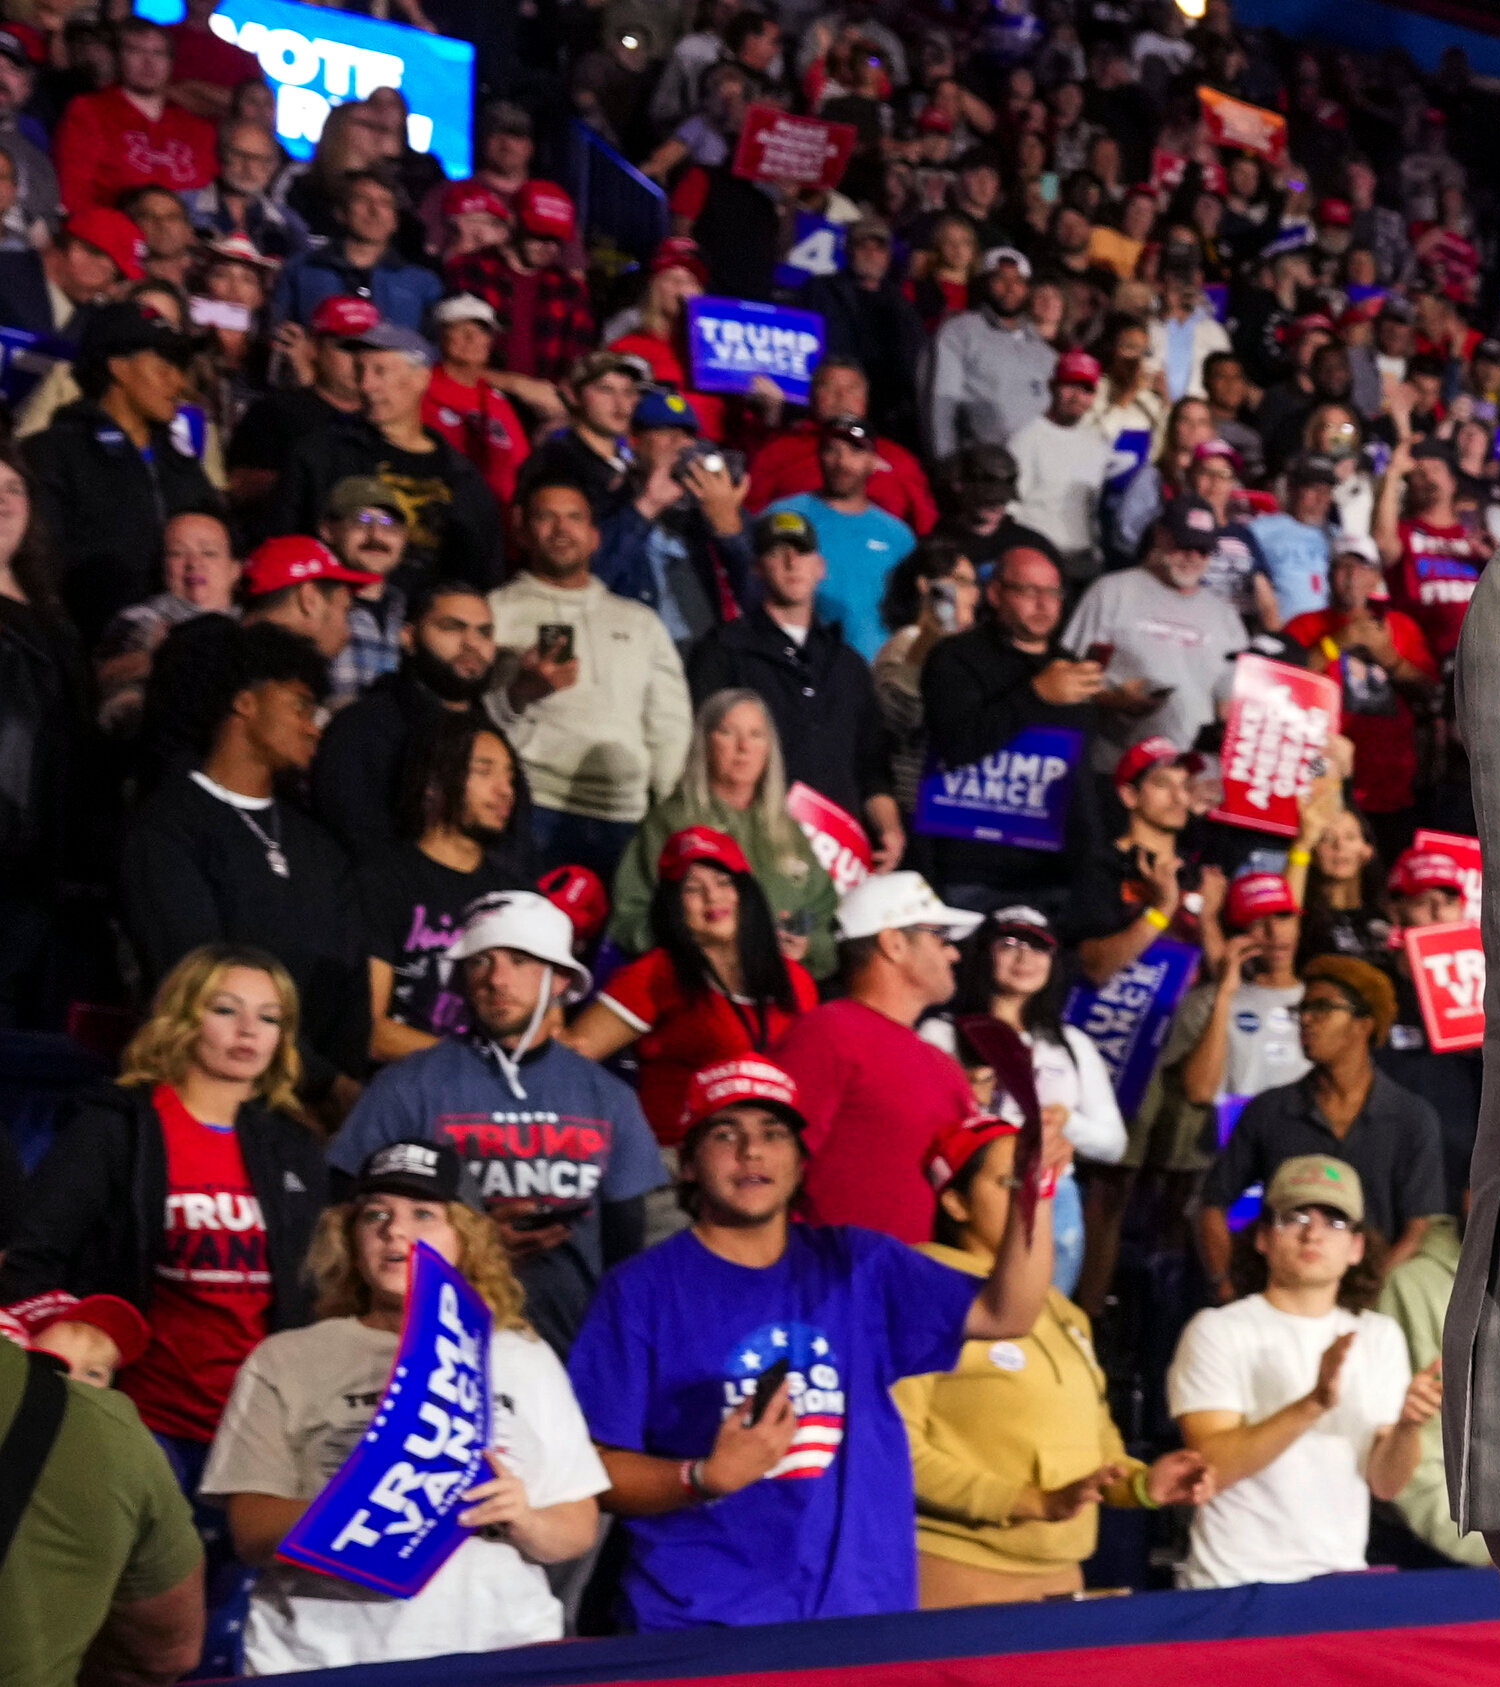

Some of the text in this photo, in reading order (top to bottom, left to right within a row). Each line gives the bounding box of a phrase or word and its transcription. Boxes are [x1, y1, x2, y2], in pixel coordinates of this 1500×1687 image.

[208, 13, 404, 100] VOTE
[697, 316, 819, 354] TRUMP
[964, 749, 1068, 788] UMP
[443, 1124, 605, 1160] TRUMP
[469, 1159, 601, 1198] ANCE
[331, 1282, 466, 1551] TRUMP
[384, 1326, 479, 1536] VANCE
